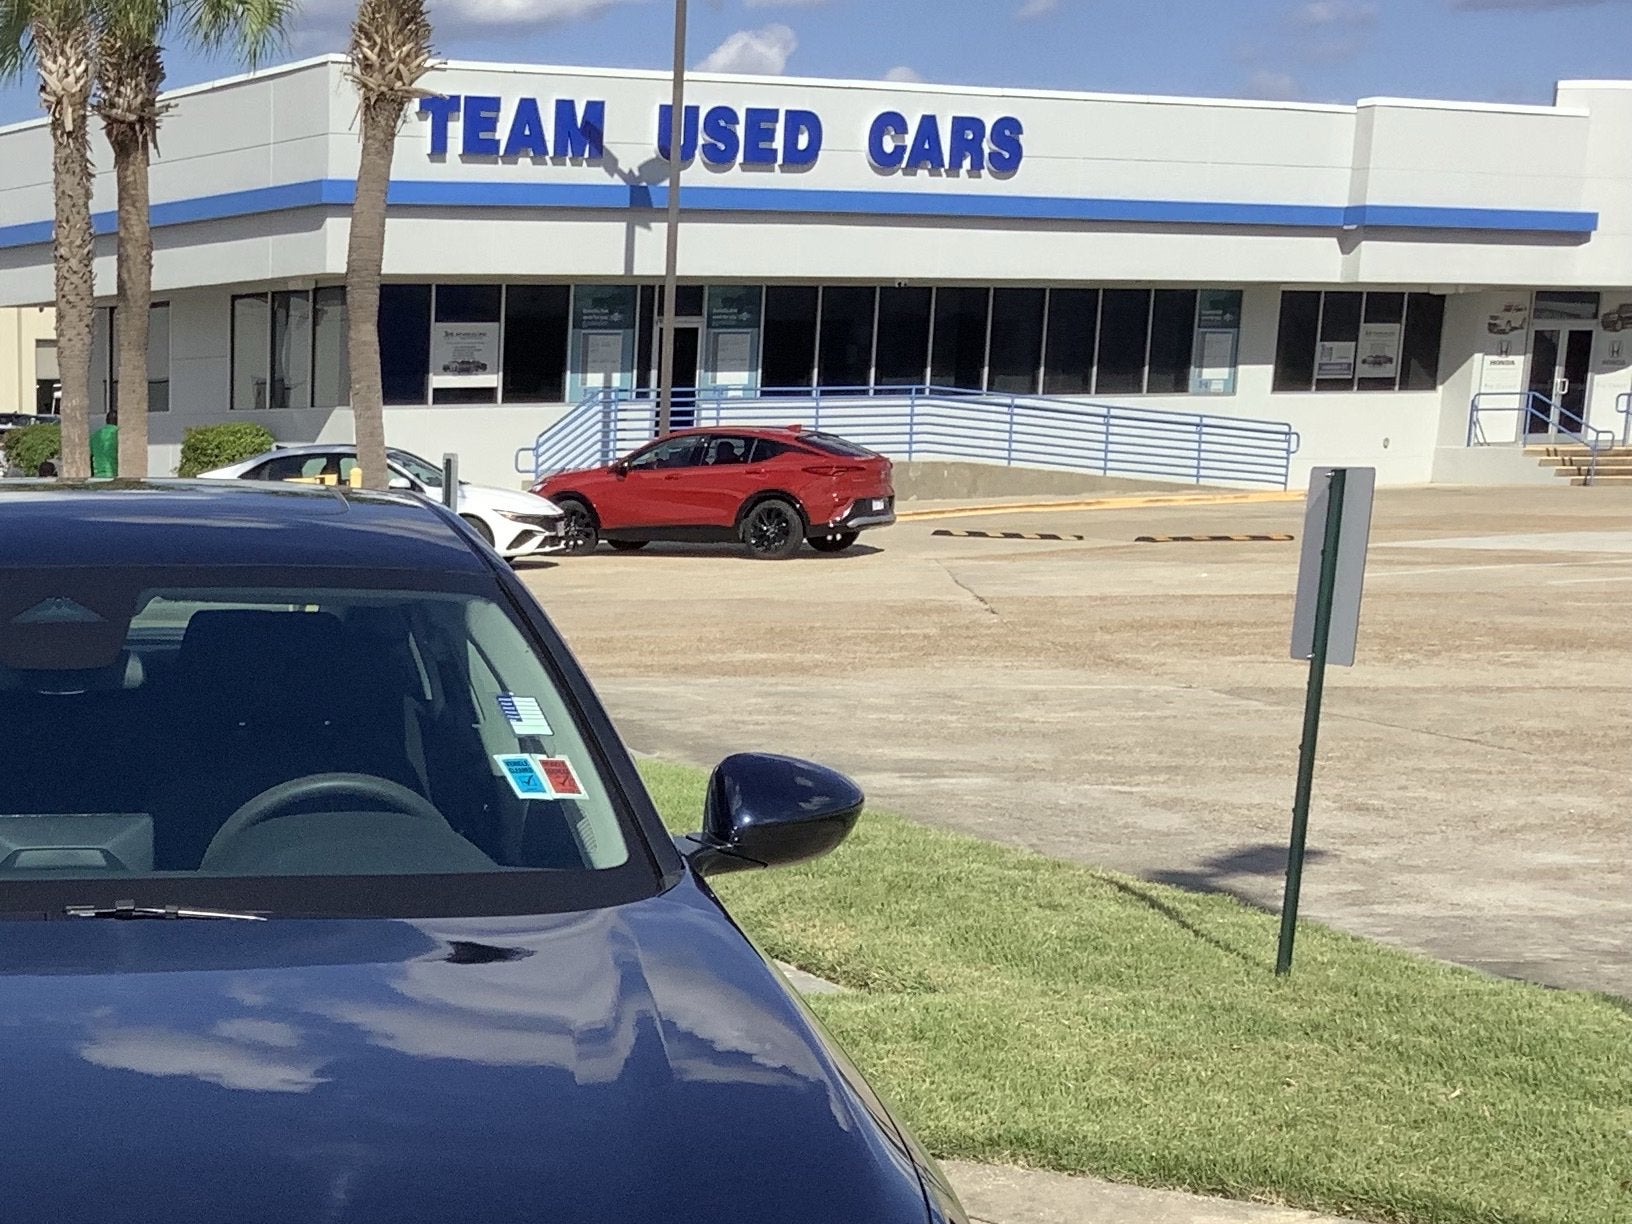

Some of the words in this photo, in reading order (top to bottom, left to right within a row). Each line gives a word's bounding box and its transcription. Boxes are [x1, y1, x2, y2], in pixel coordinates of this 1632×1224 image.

[419, 95, 605, 161] TEAM
[657, 104, 823, 166] USED
[867, 110, 1024, 174] CARS
